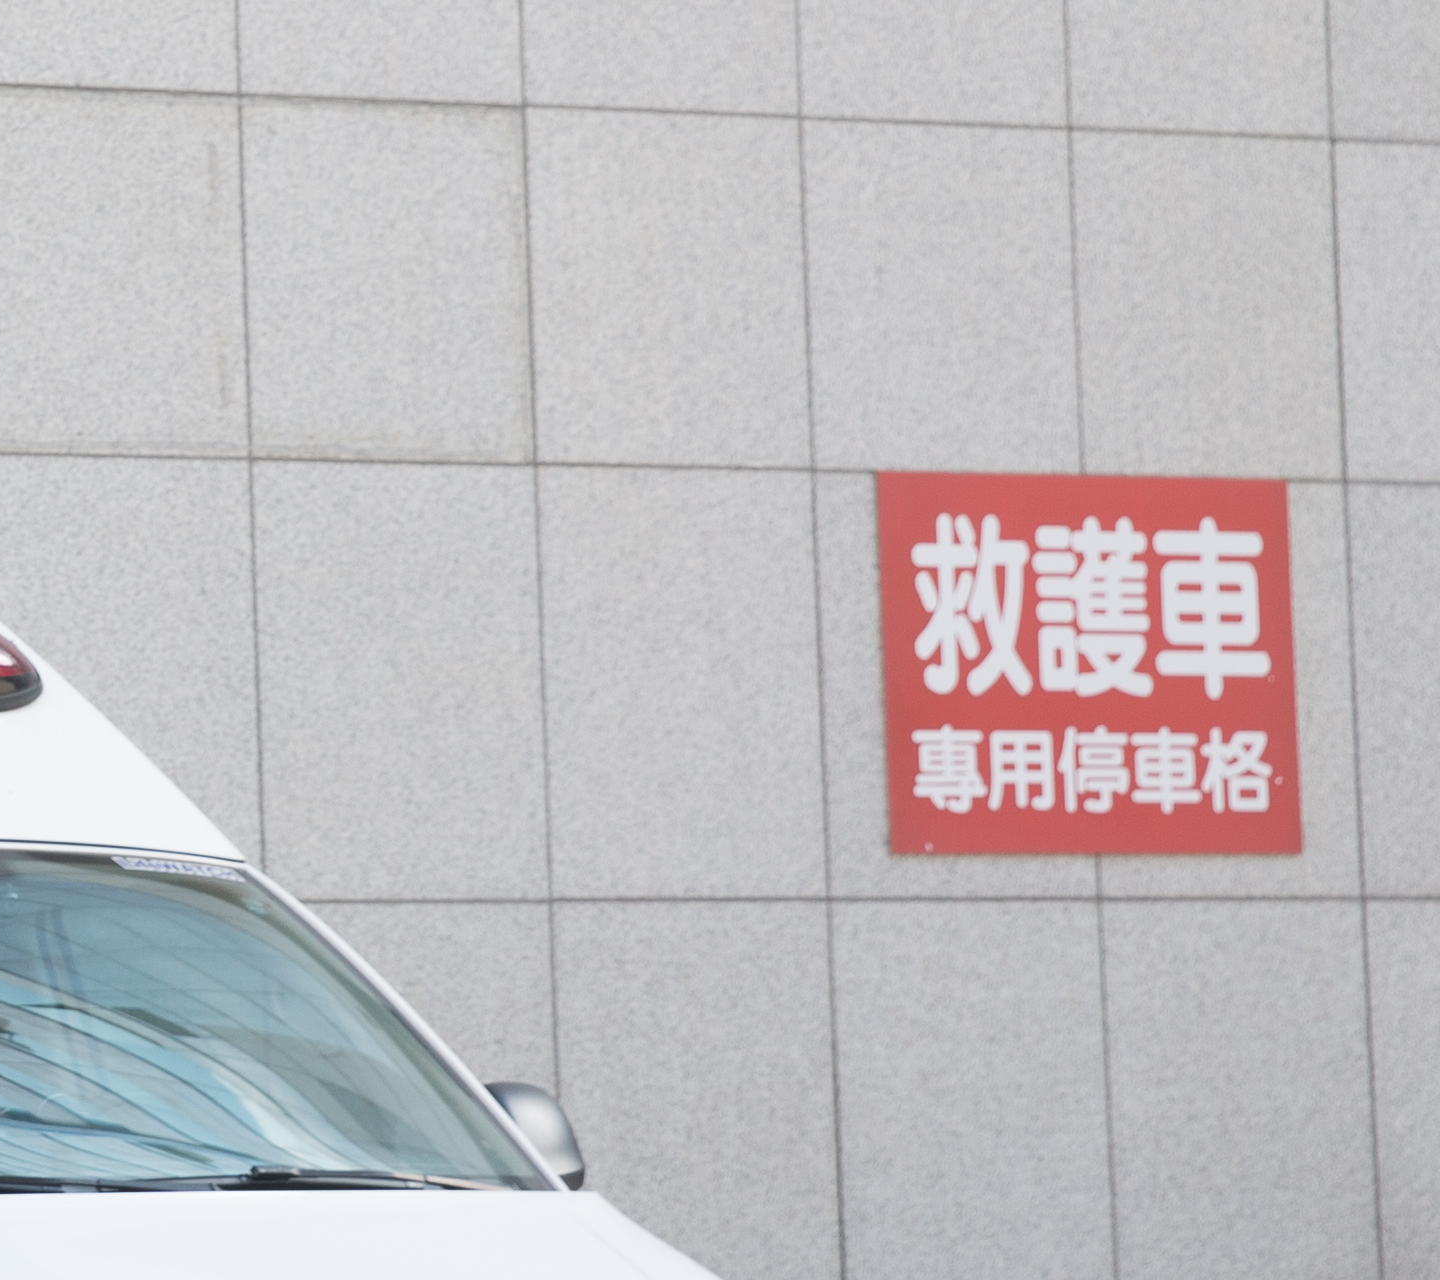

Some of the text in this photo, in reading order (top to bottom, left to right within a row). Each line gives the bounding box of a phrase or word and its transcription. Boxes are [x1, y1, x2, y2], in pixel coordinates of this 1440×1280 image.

[910, 511, 1273, 701] 救護車
[911, 723, 1274, 815] 專用停車格
